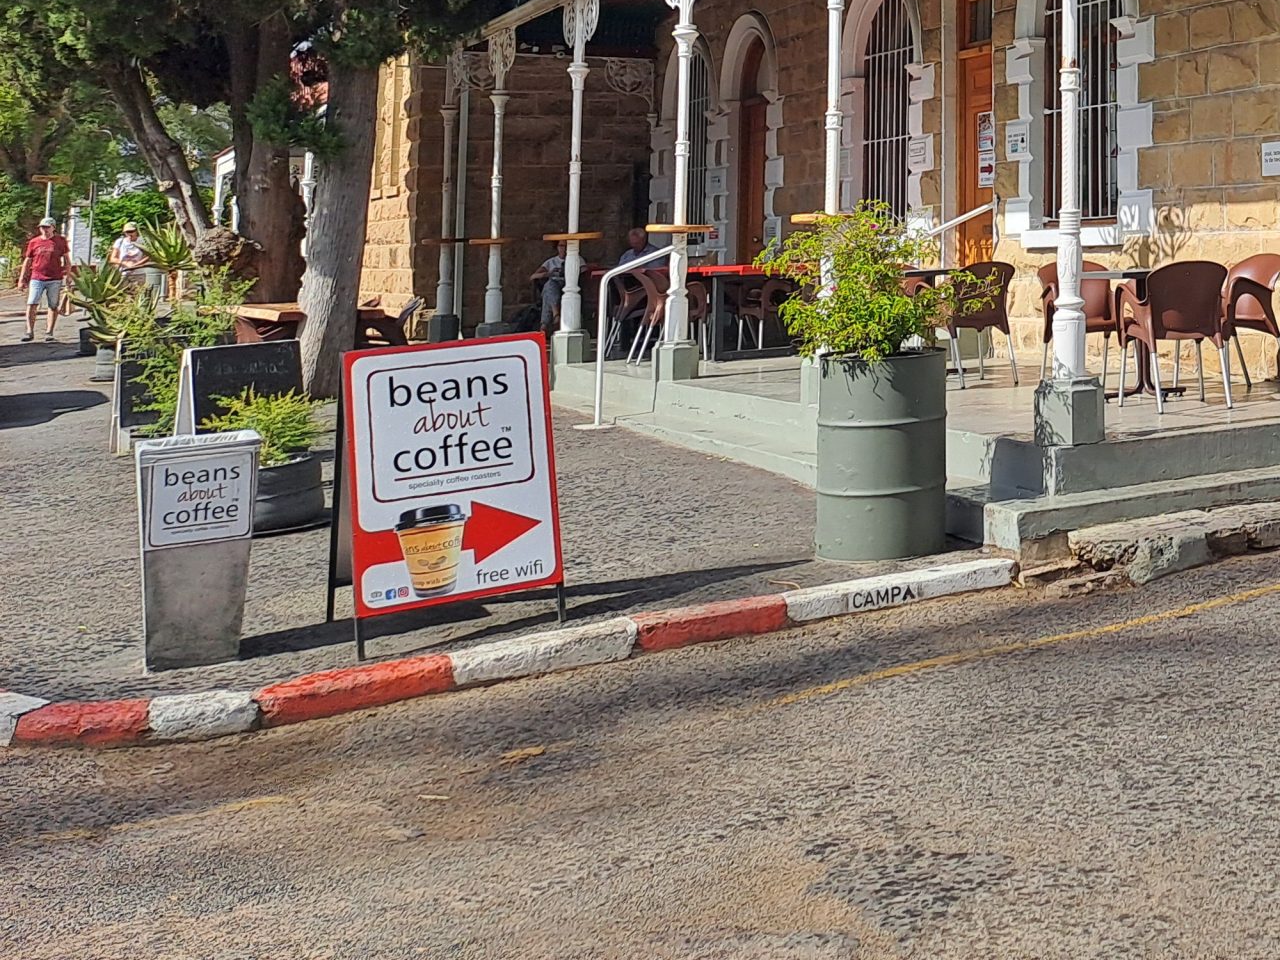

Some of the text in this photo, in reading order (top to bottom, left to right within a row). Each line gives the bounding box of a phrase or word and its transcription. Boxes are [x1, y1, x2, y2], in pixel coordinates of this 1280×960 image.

[389, 373, 509, 407] beans
[413, 396, 492, 434] about
[393, 432, 512, 473] coffee
[164, 465, 240, 487] beans
[446, 474, 469, 485] coffee
[471, 470, 502, 481] roasters
[177, 480, 228, 503] about
[163, 501, 239, 525] coffee
[476, 567, 510, 584] free
[515, 559, 544, 578] wifi
